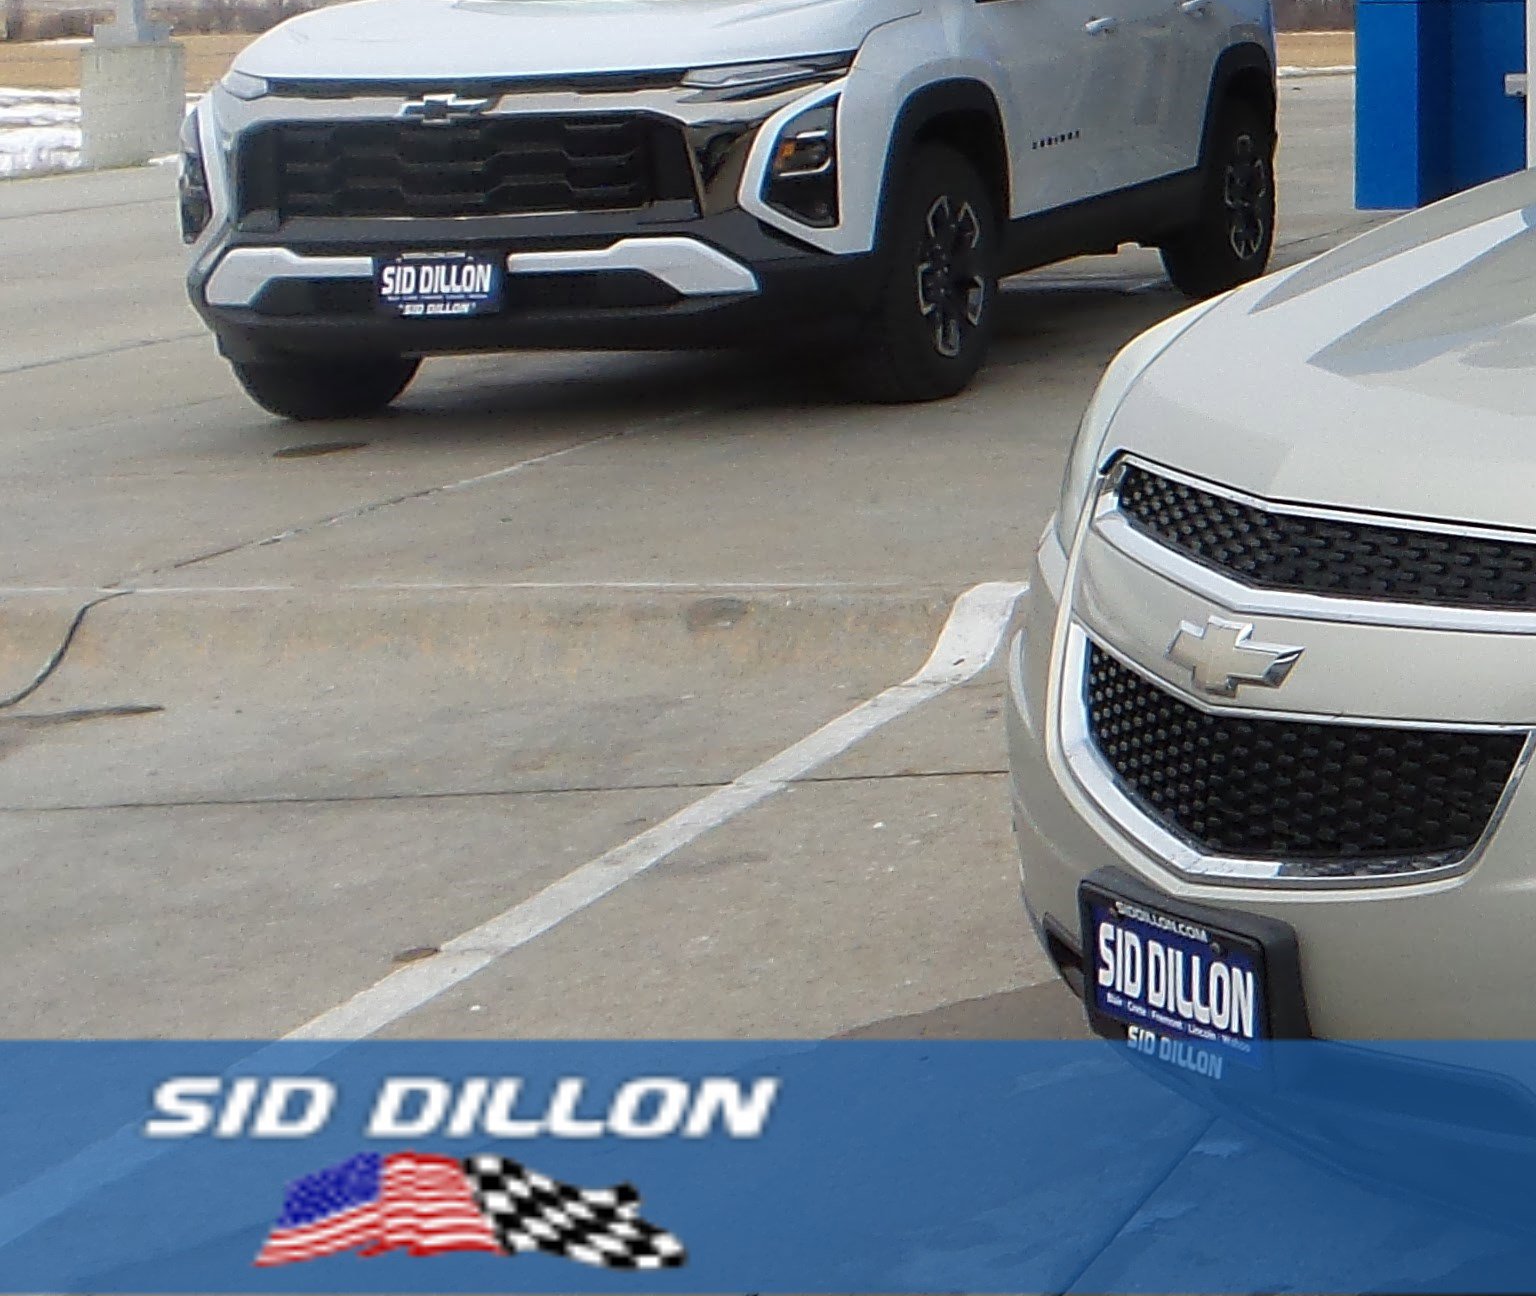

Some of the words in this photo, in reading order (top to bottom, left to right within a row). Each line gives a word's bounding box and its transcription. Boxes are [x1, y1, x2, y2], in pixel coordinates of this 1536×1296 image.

[381, 265, 416, 294] SID
[418, 264, 492, 294] DILLON
[1098, 921, 1143, 1000] SID
[1147, 939, 1254, 1039] DILLON
[1127, 1024, 1156, 1055] SID
[1159, 1035, 1223, 1080] DILLON
